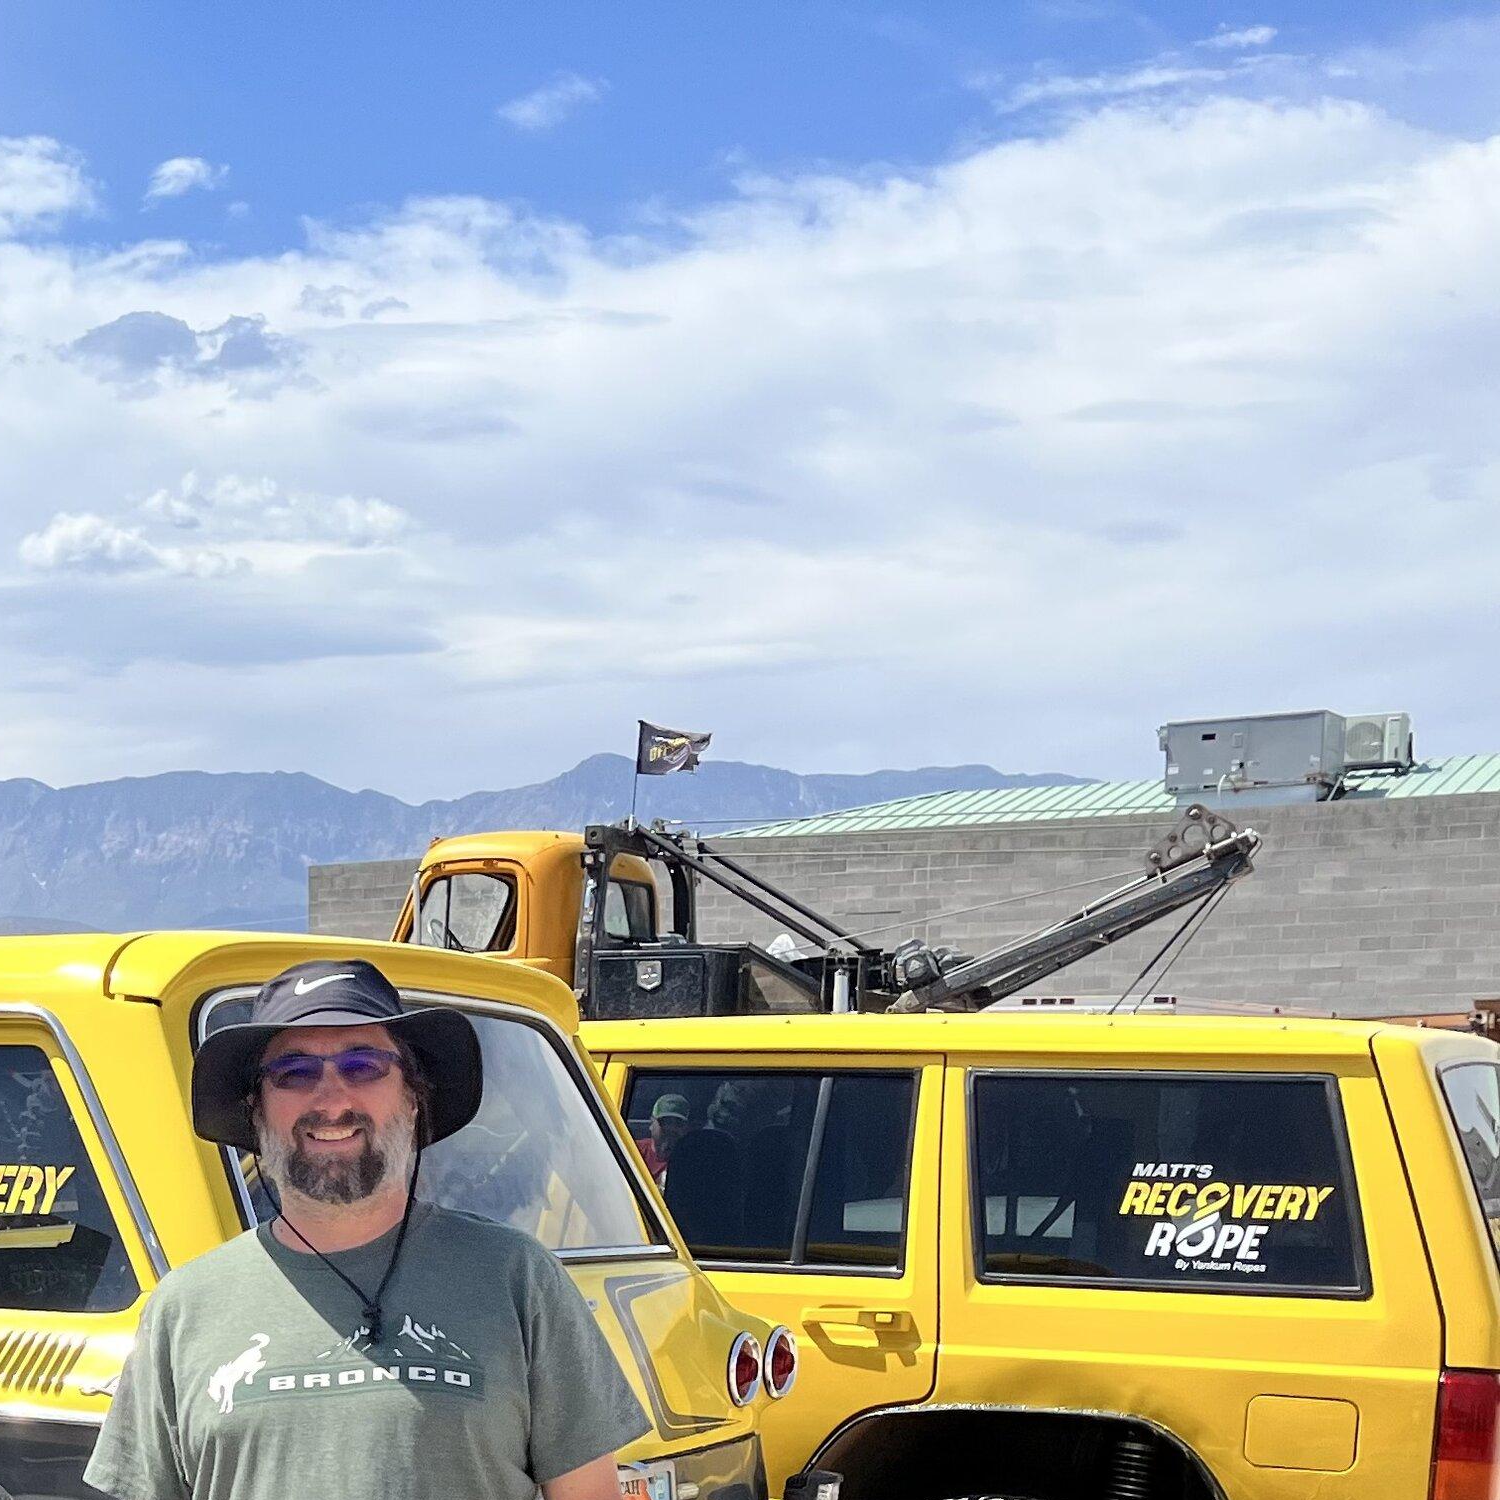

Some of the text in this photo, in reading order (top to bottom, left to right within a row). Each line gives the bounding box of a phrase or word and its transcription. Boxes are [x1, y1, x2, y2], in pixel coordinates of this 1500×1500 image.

[1132, 1163, 1214, 1179] MATT'S
[1118, 1181, 1335, 1221] RECOVERY
[1144, 1211, 1269, 1260] ROPE
[1175, 1258, 1190, 1271] By
[269, 1365, 471, 1391] BRONCO
